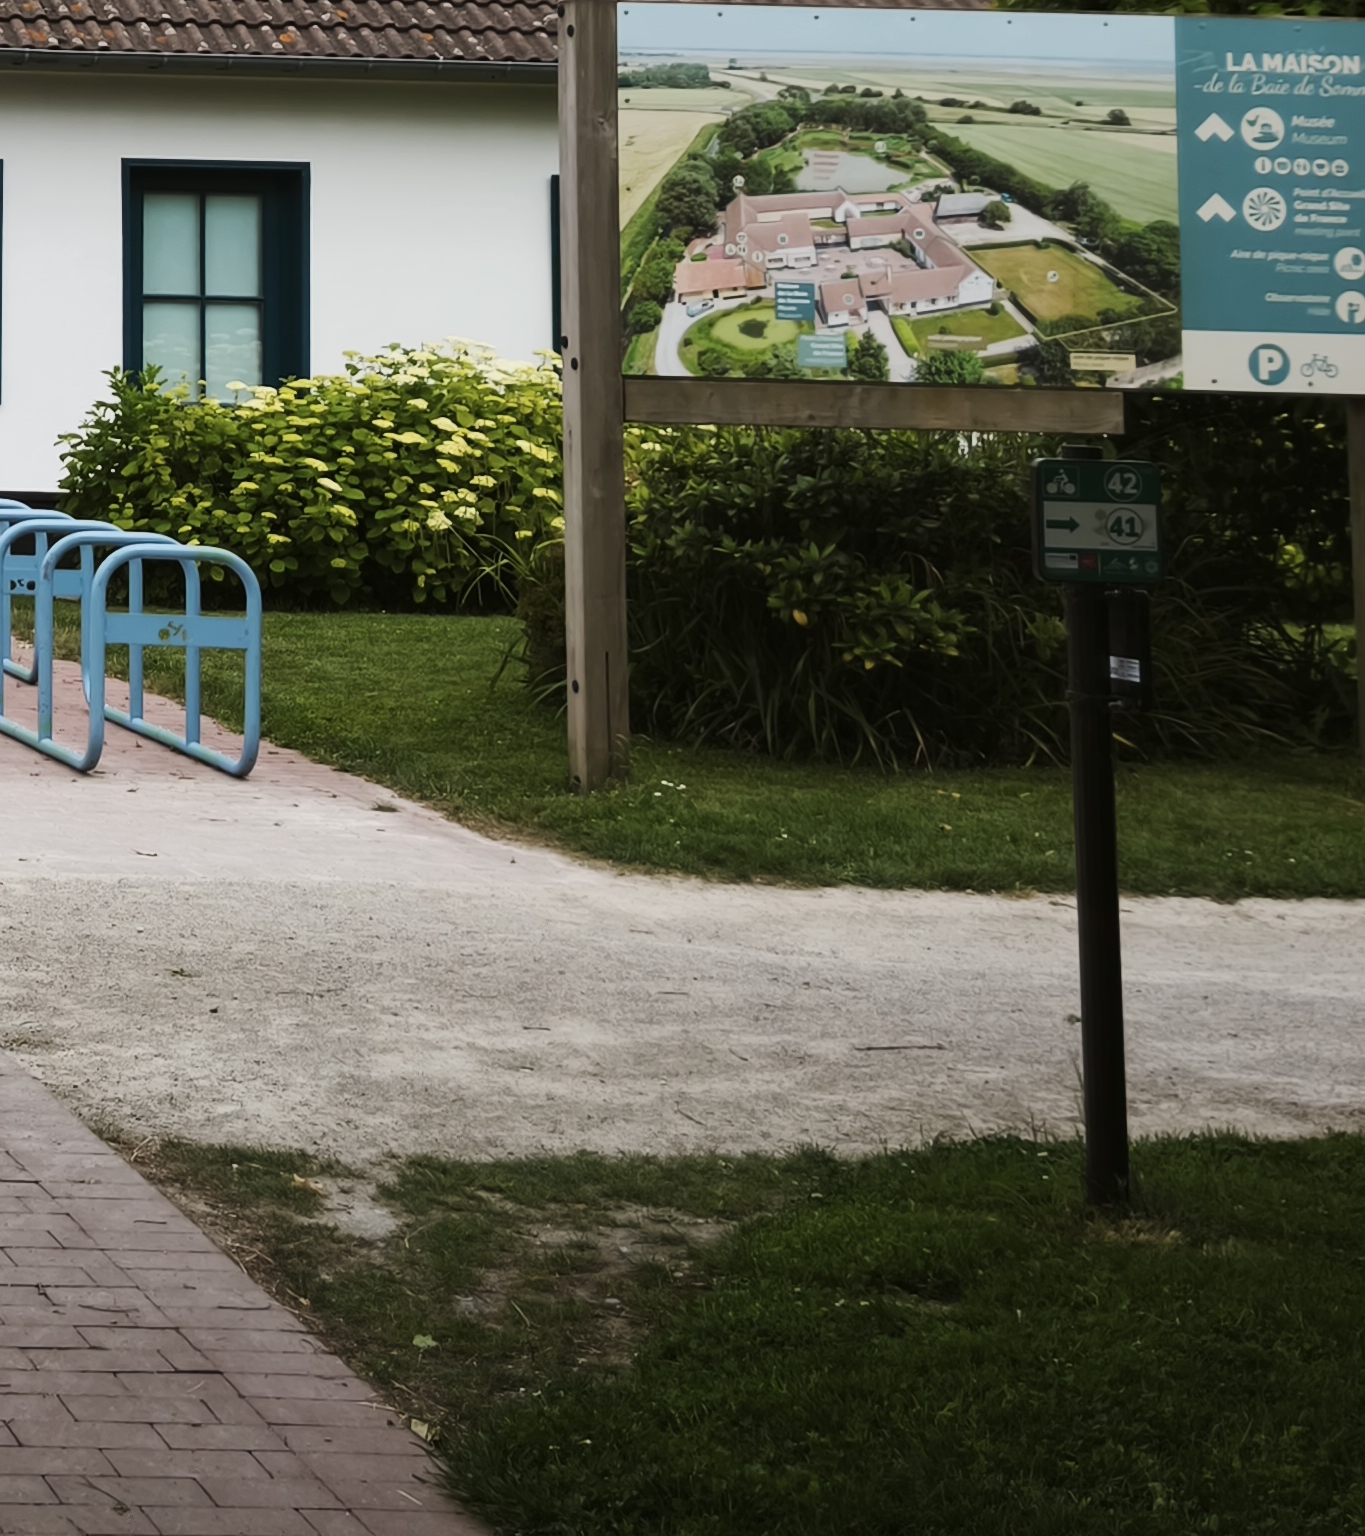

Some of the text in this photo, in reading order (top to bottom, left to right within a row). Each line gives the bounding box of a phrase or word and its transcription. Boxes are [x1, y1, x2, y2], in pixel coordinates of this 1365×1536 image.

[1226, 52, 1361, 75] LA MAISON
[1228, 74, 1245, 94] la
[1251, 74, 1290, 95] Baie
[1293, 75, 1315, 96] de
[1107, 472, 1138, 494] 42
[1109, 515, 1141, 537] 41
